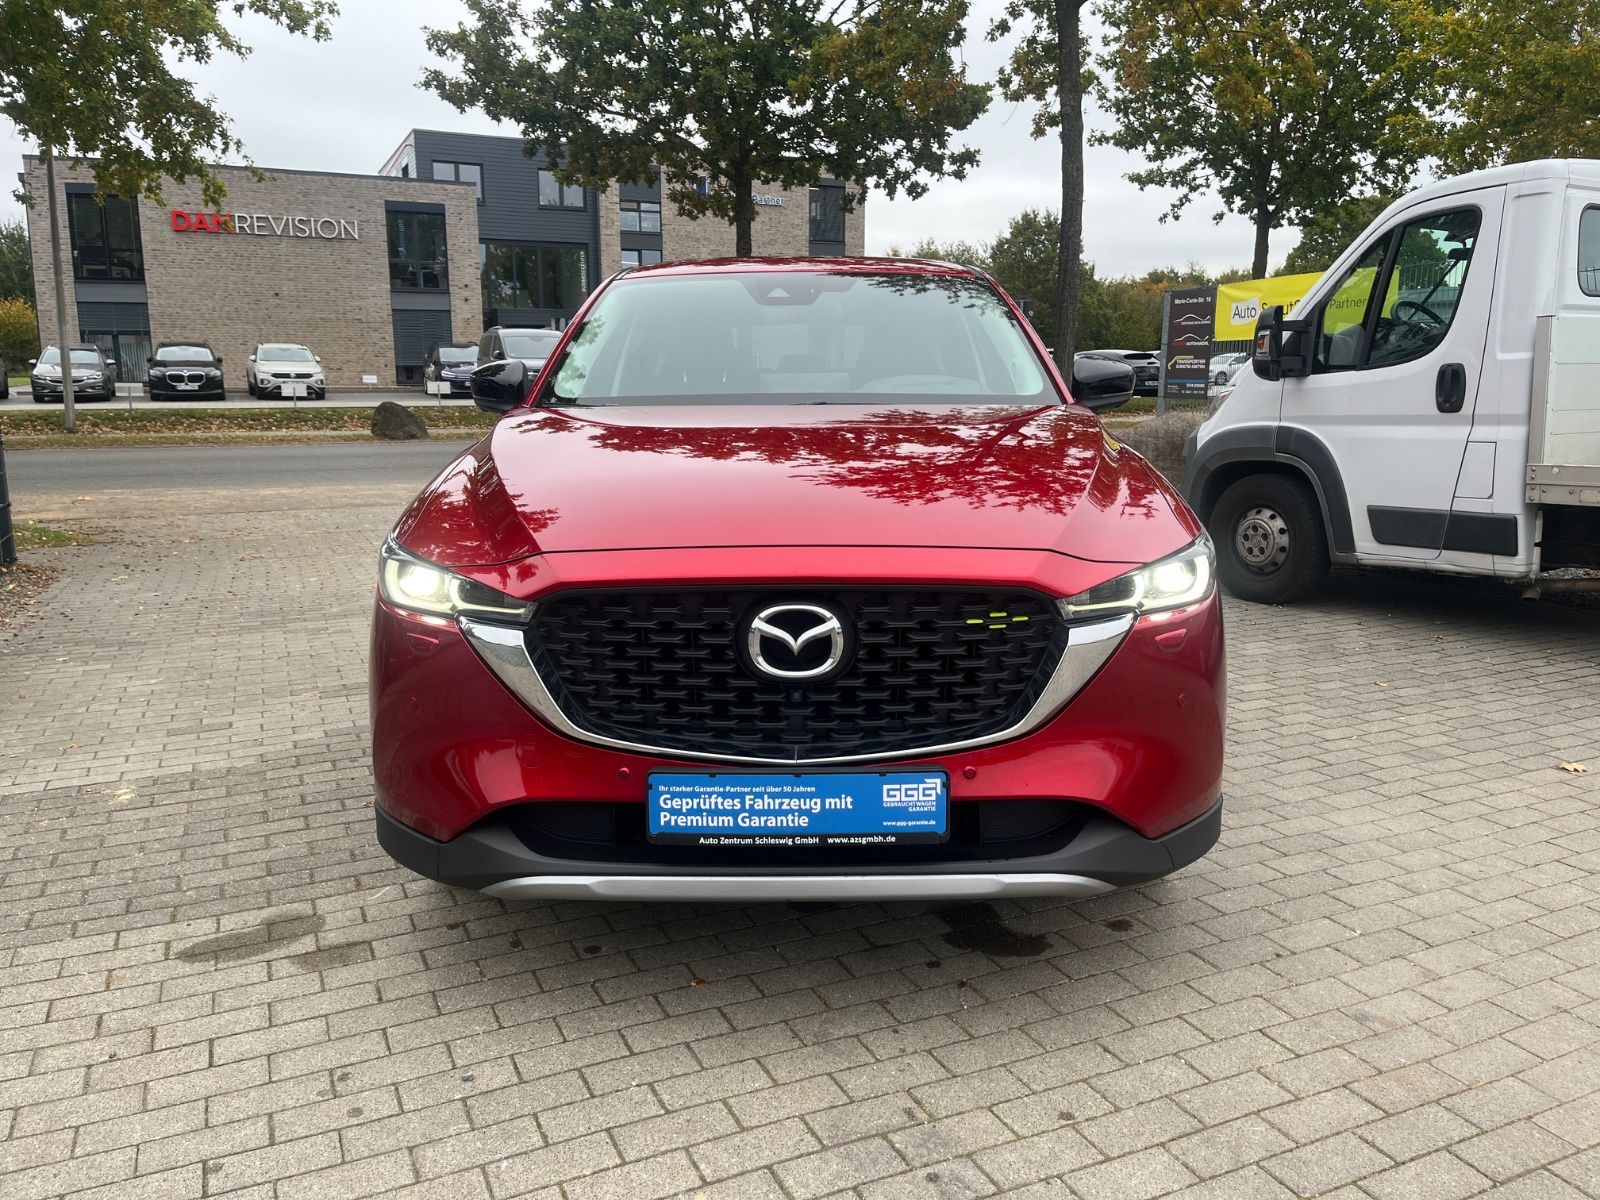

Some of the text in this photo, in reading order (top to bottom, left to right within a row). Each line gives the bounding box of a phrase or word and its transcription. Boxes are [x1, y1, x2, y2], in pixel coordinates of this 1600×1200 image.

[1232, 305, 1257, 319] Auto
[1329, 298, 1367, 310] Partner
[694, 785, 751, 793] Garantie-Partner
[660, 794, 853, 813] Geprüftes Fahrzeug mit
[660, 812, 809, 827] Premium Garantie
[719, 837, 753, 845] Zentrum
[754, 836, 793, 846] Schleswig
[794, 836, 819, 844] GmbH
[827, 835, 896, 845] www.azsgmbh.de
